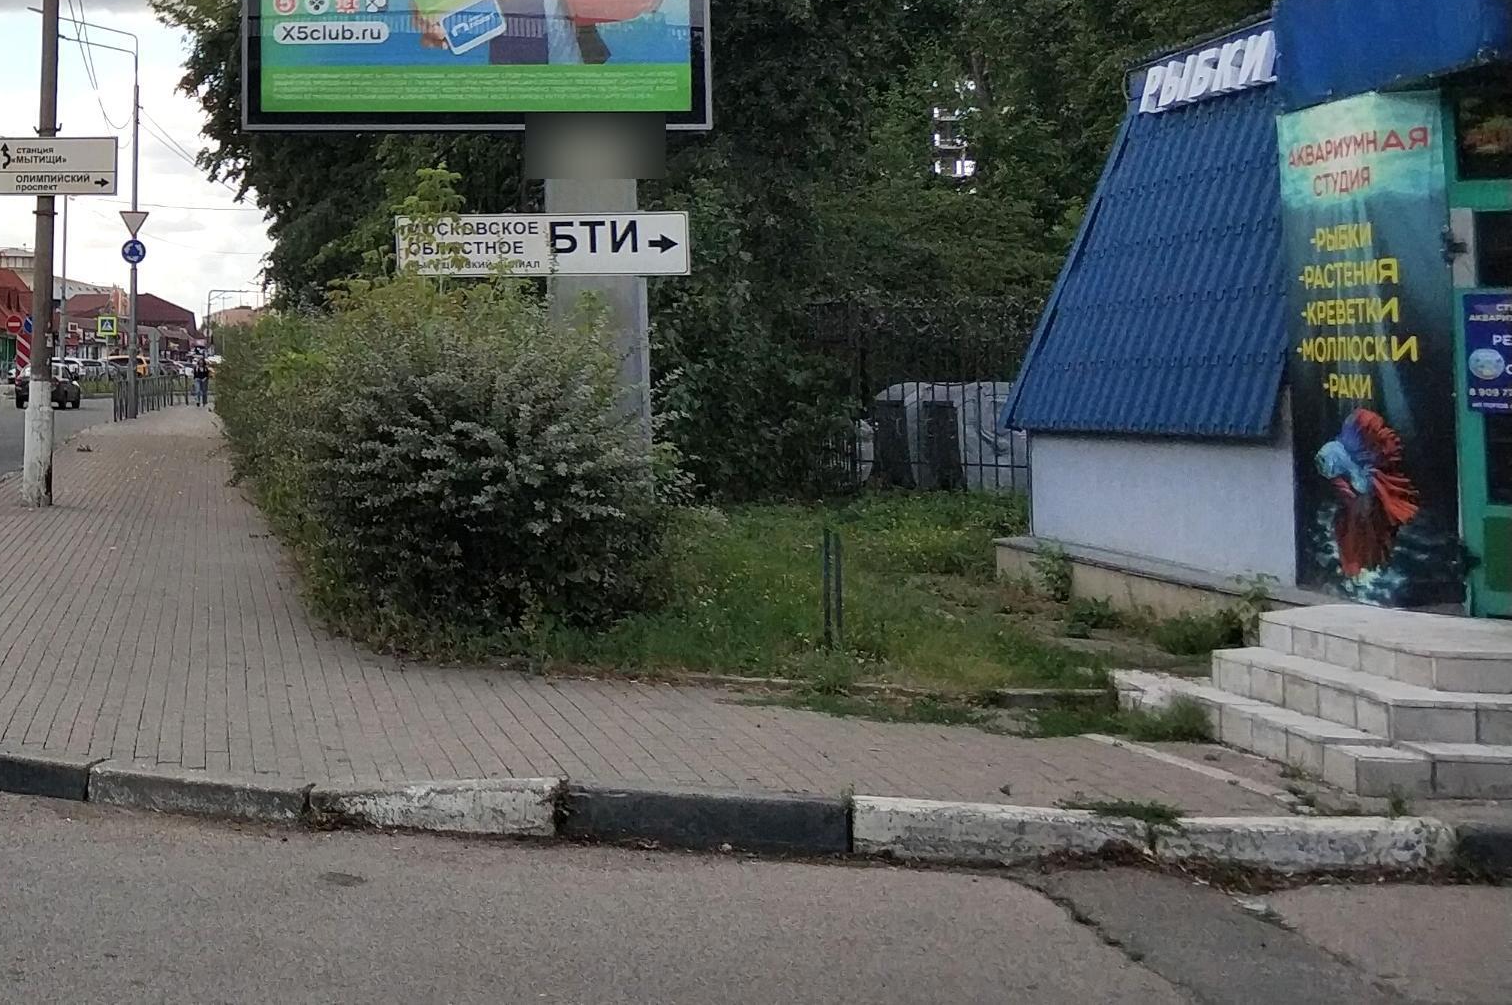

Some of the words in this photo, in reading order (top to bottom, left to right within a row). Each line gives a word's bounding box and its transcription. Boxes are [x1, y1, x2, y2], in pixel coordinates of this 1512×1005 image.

[281, 24, 381, 41] X5club.ru
[1139, 30, 1276, 113] РЫБКИ
[11, 155, 67, 164] «МЫТИЩИ»
[16, 147, 53, 155] станция
[1289, 127, 1429, 167] АКВАРИУМНАЯ
[16, 174, 90, 183] ОЛИМПИЙСКИЙ
[16, 184, 57, 192] проспект
[1313, 167, 1370, 196] СТУДИЯ
[549, 220, 638, 253] БТИ
[1310, 222, 1372, 252] -РЫБКИ
[1299, 258, 1399, 290] -РАСТЕНИЯ
[1301, 297, 1399, 326] -КРЕВЕТКИ
[1296, 336, 1419, 362] -МОЛЛЮСКИ
[1323, 373, 1372, 399] -РАКИ
